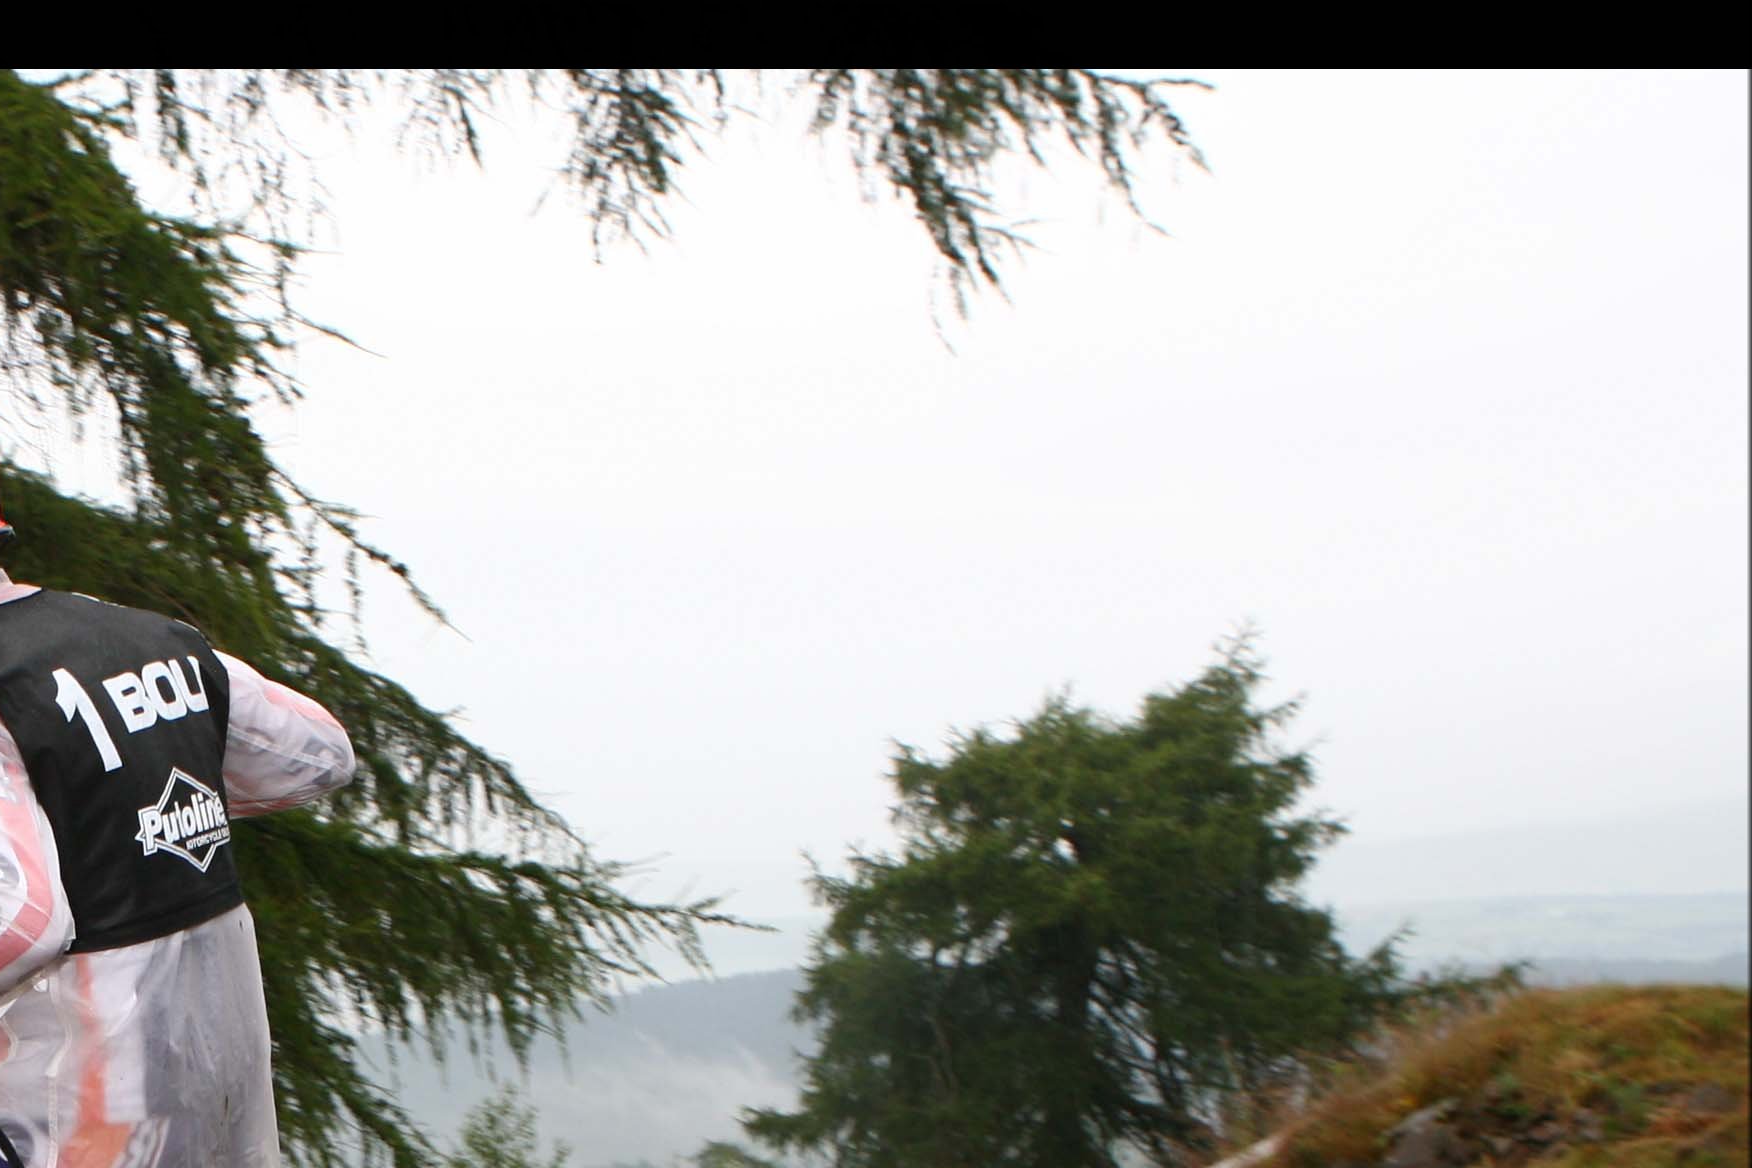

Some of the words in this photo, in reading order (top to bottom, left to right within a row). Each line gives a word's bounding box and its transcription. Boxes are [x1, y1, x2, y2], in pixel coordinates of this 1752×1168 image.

[52, 668, 123, 772] 1
[102, 656, 209, 733] BOU
[141, 792, 228, 851] Putoline
